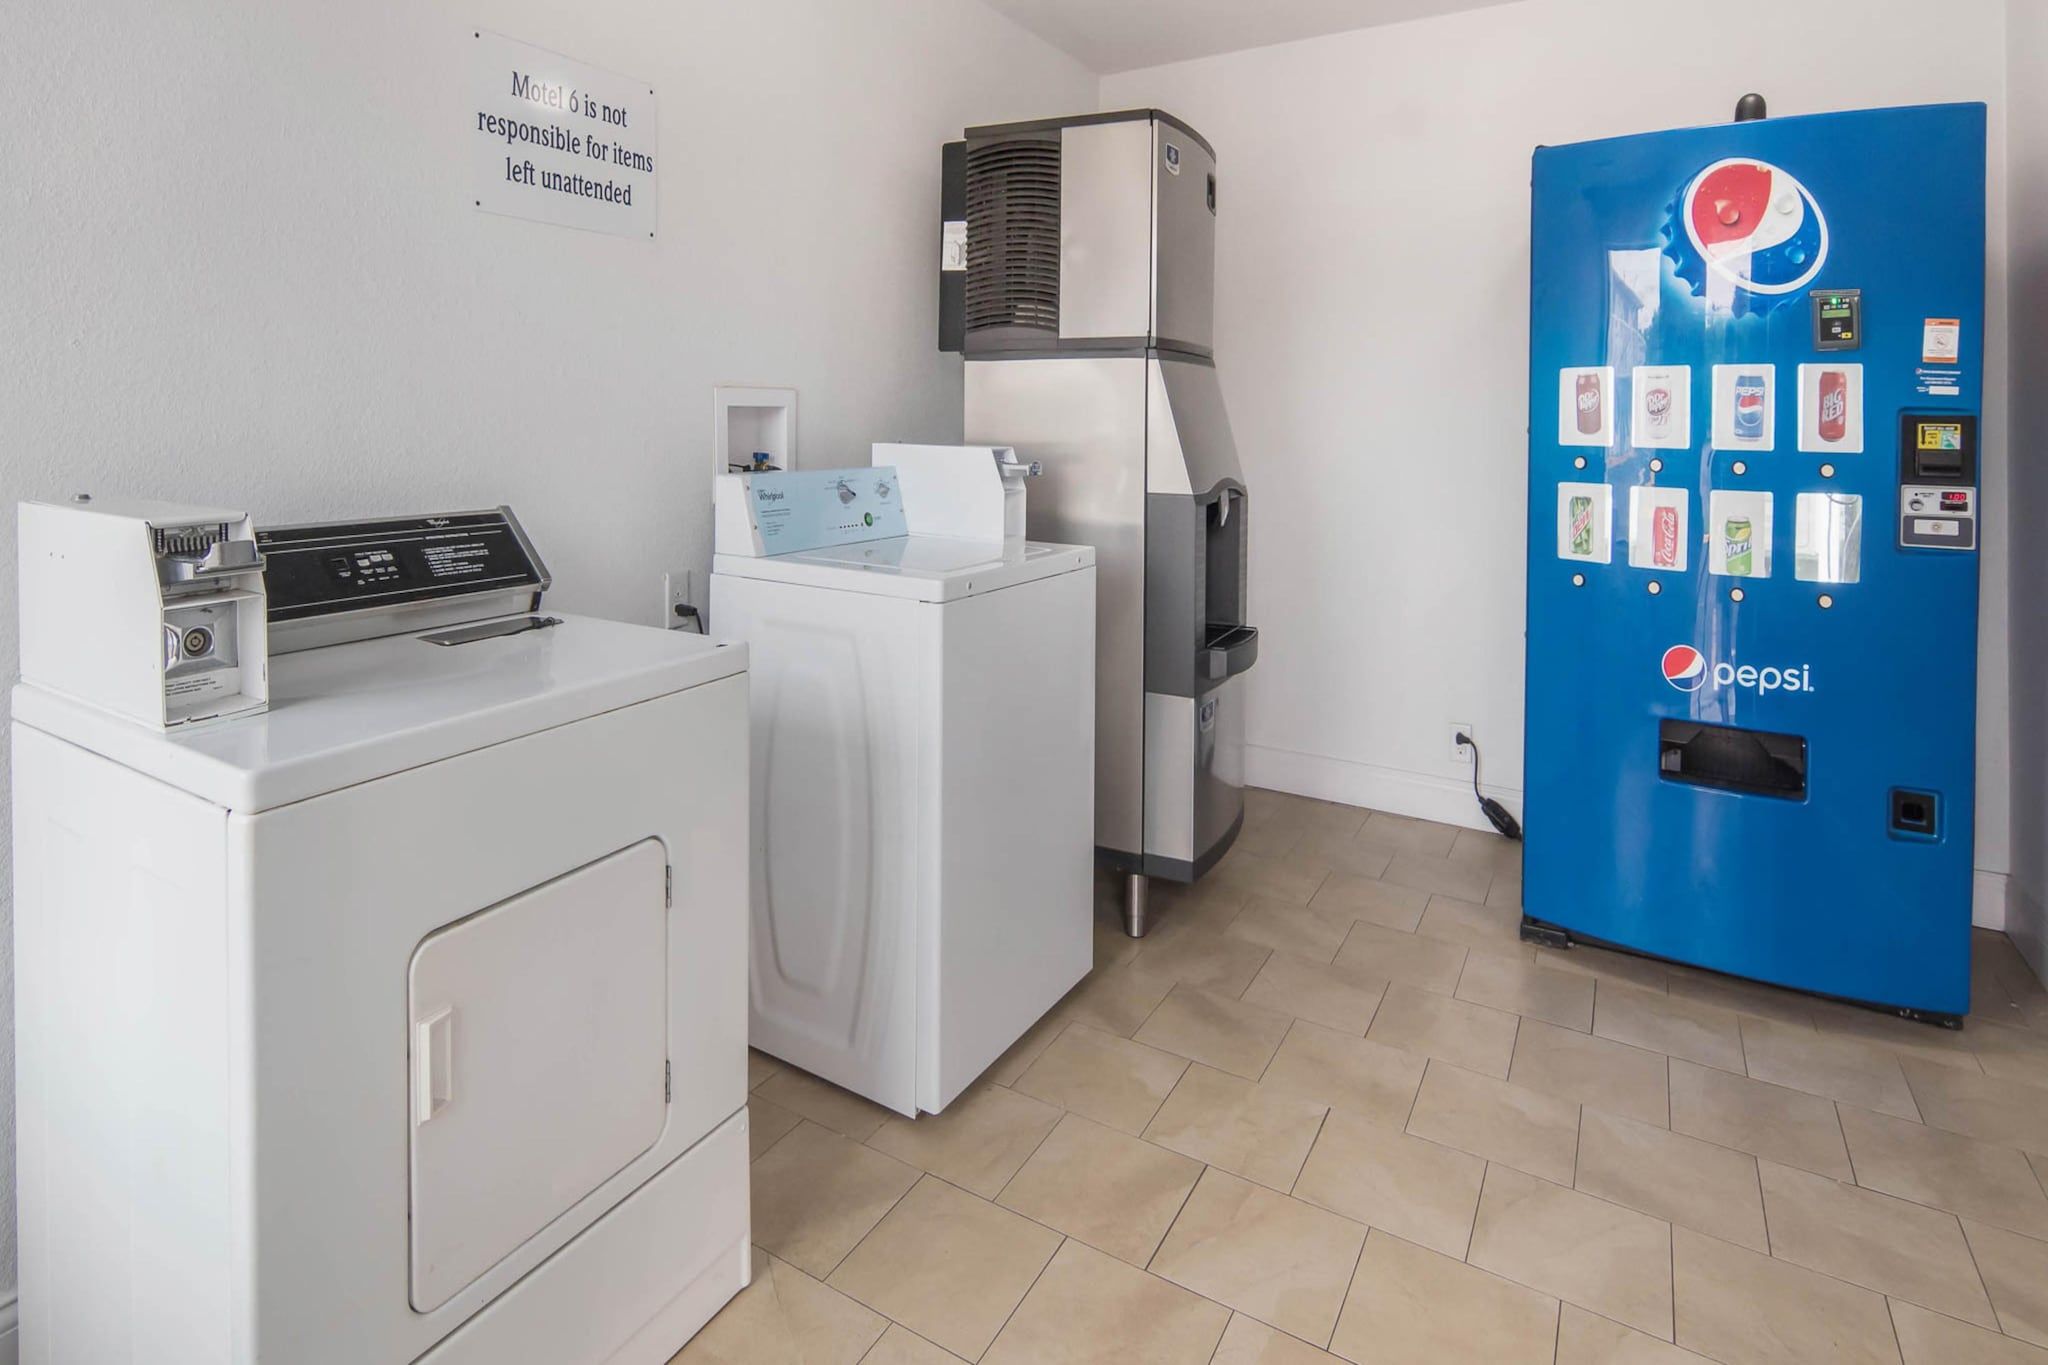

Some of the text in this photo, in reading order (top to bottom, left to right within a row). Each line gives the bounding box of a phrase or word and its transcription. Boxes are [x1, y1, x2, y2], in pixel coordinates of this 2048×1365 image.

[511, 70, 628, 128] Motel 6 is not
[477, 111, 653, 173] responsible for items
[505, 156, 632, 207] left unattended
